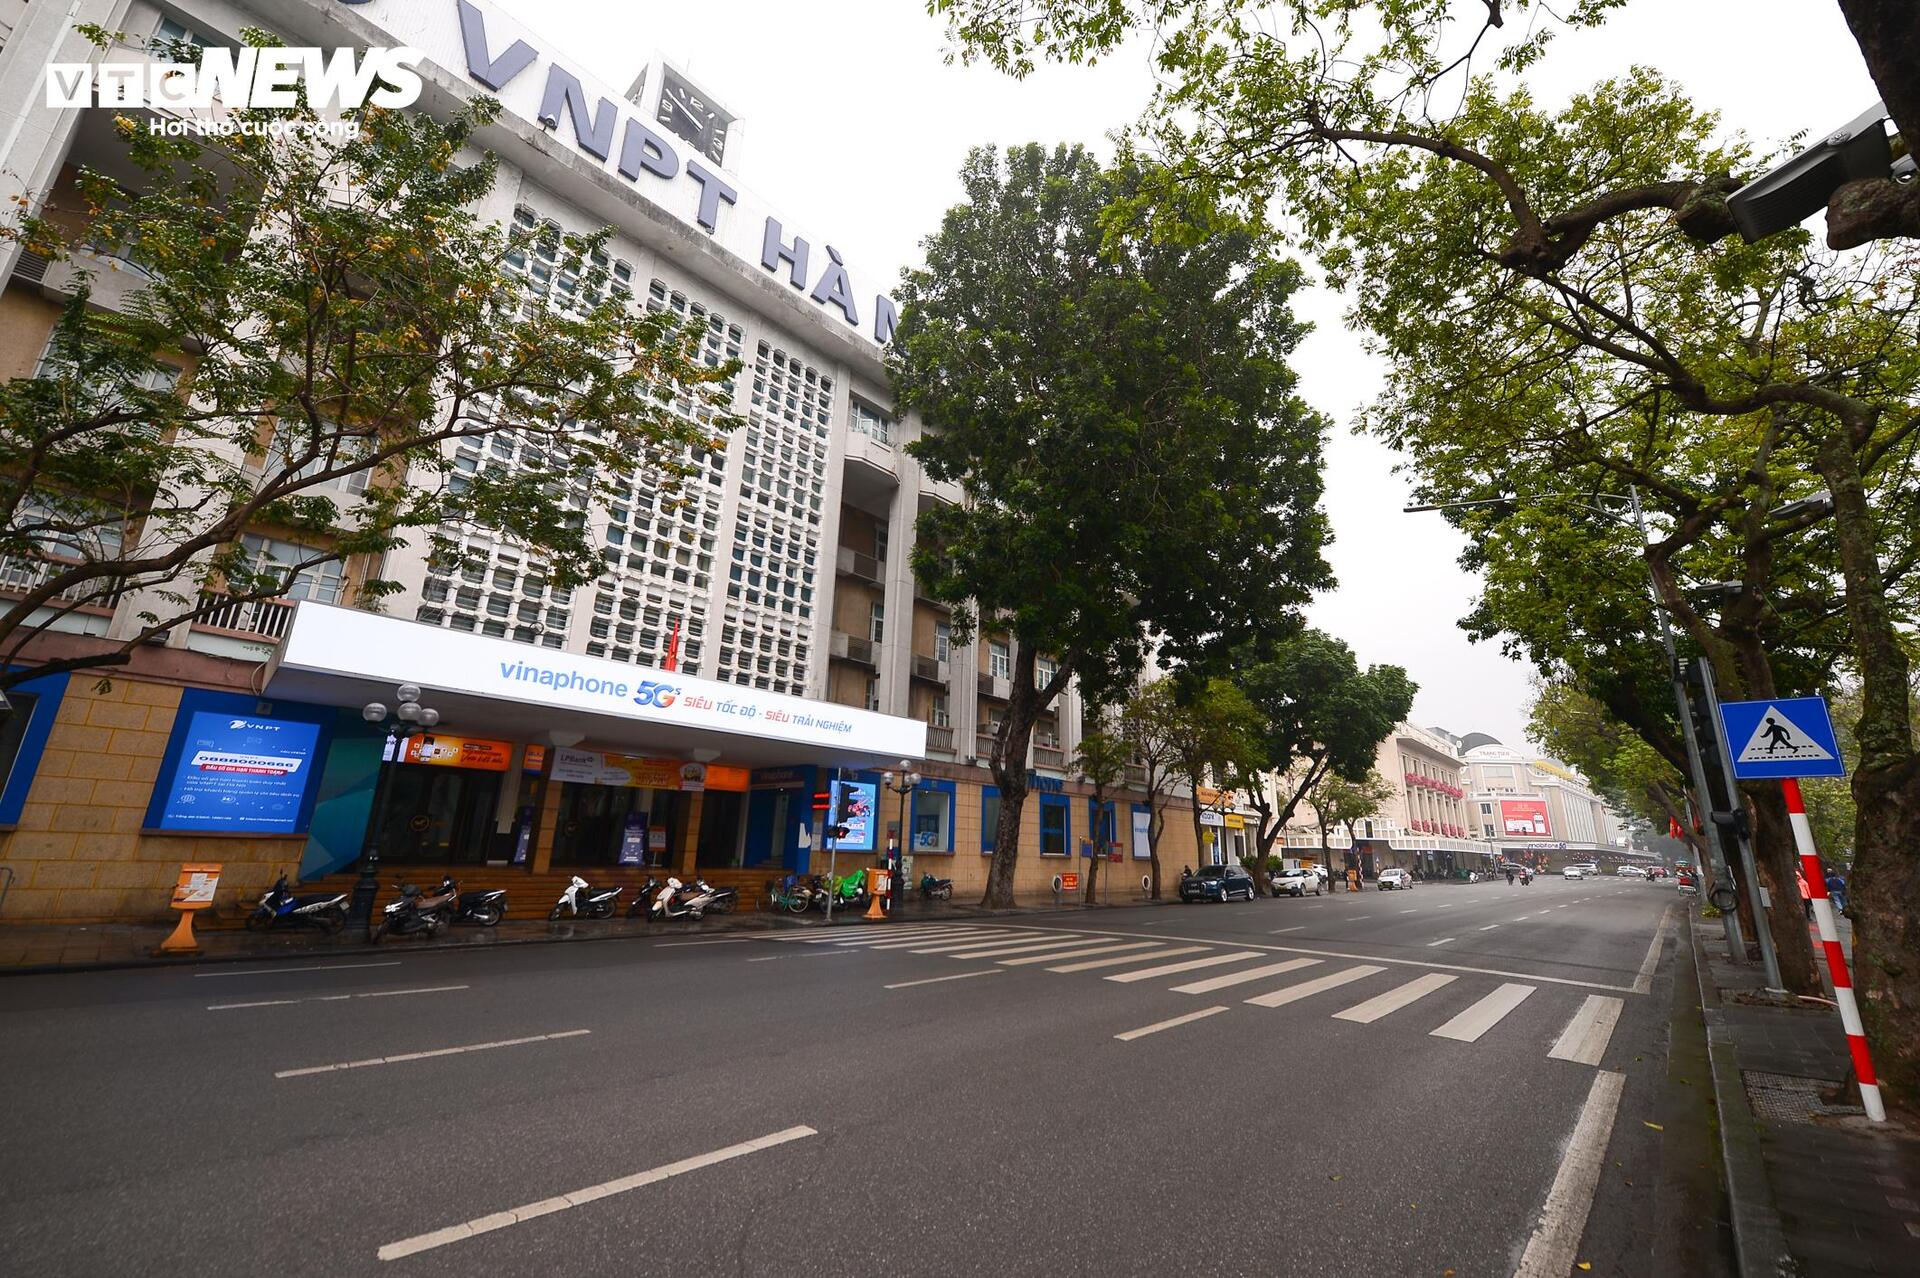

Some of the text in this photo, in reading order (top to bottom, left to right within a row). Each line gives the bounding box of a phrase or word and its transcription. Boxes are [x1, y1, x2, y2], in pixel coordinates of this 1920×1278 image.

[457, 0, 738, 233] VNPT
[761, 216, 859, 326] HÀ
[500, 661, 628, 698] vinaphone
[246, 723, 280, 731] VNPT
[683, 696, 713, 711] SIÊU
[716, 699, 737, 715] TỐC
[739, 704, 757, 720] ĐỘ
[764, 709, 790, 723] SIÊU
[792, 714, 814, 728] TRẢI
[815, 719, 853, 735] NGHIỆM
